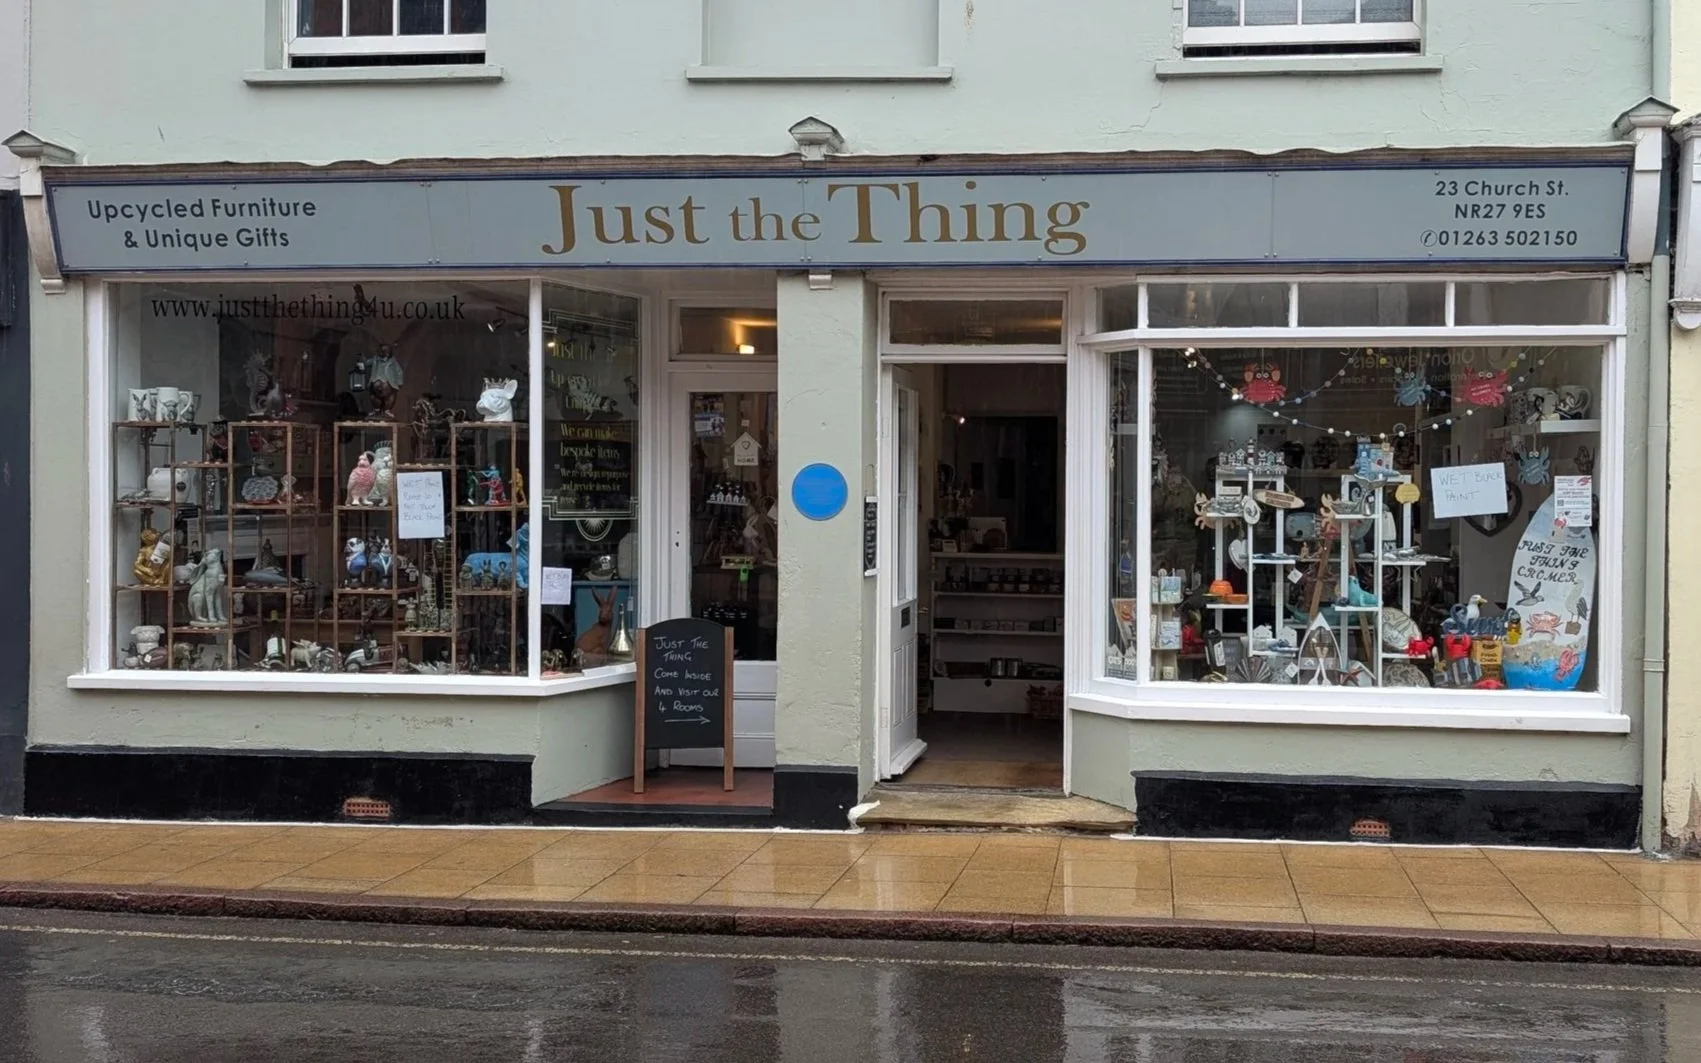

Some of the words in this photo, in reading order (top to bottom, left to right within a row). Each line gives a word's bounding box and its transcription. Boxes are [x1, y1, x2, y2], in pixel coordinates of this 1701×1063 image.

[1435, 180, 1458, 196] 23
[1464, 180, 1540, 196] Church
[1546, 180, 1569, 196] St.
[88, 198, 205, 223] Upcycled
[211, 197, 317, 218] Furniture
[541, 183, 710, 255] Just
[727, 196, 822, 242] the
[827, 179, 1090, 256] Thing
[1454, 203, 1507, 219] NR27
[1512, 203, 1546, 219] 9ES
[124, 229, 139, 249] &
[145, 228, 229, 252] Unique
[236, 226, 290, 248] Gifts
[1438, 230, 1499, 246] 01263
[1504, 230, 1578, 246] 502150
[151, 293, 466, 326] www.justthething4u.co.uk
[1438, 471, 1472, 486] WET
[1518, 539, 1553, 555] JUST
[1559, 545, 1590, 559] THE
[653, 636, 686, 650] JUST
[690, 636, 709, 649] THE
[663, 651, 692, 662] THING
[654, 685, 674, 696] AND
[702, 688, 720, 697] OUR
[658, 701, 667, 713] 4
[673, 701, 704, 712] ROOMS
